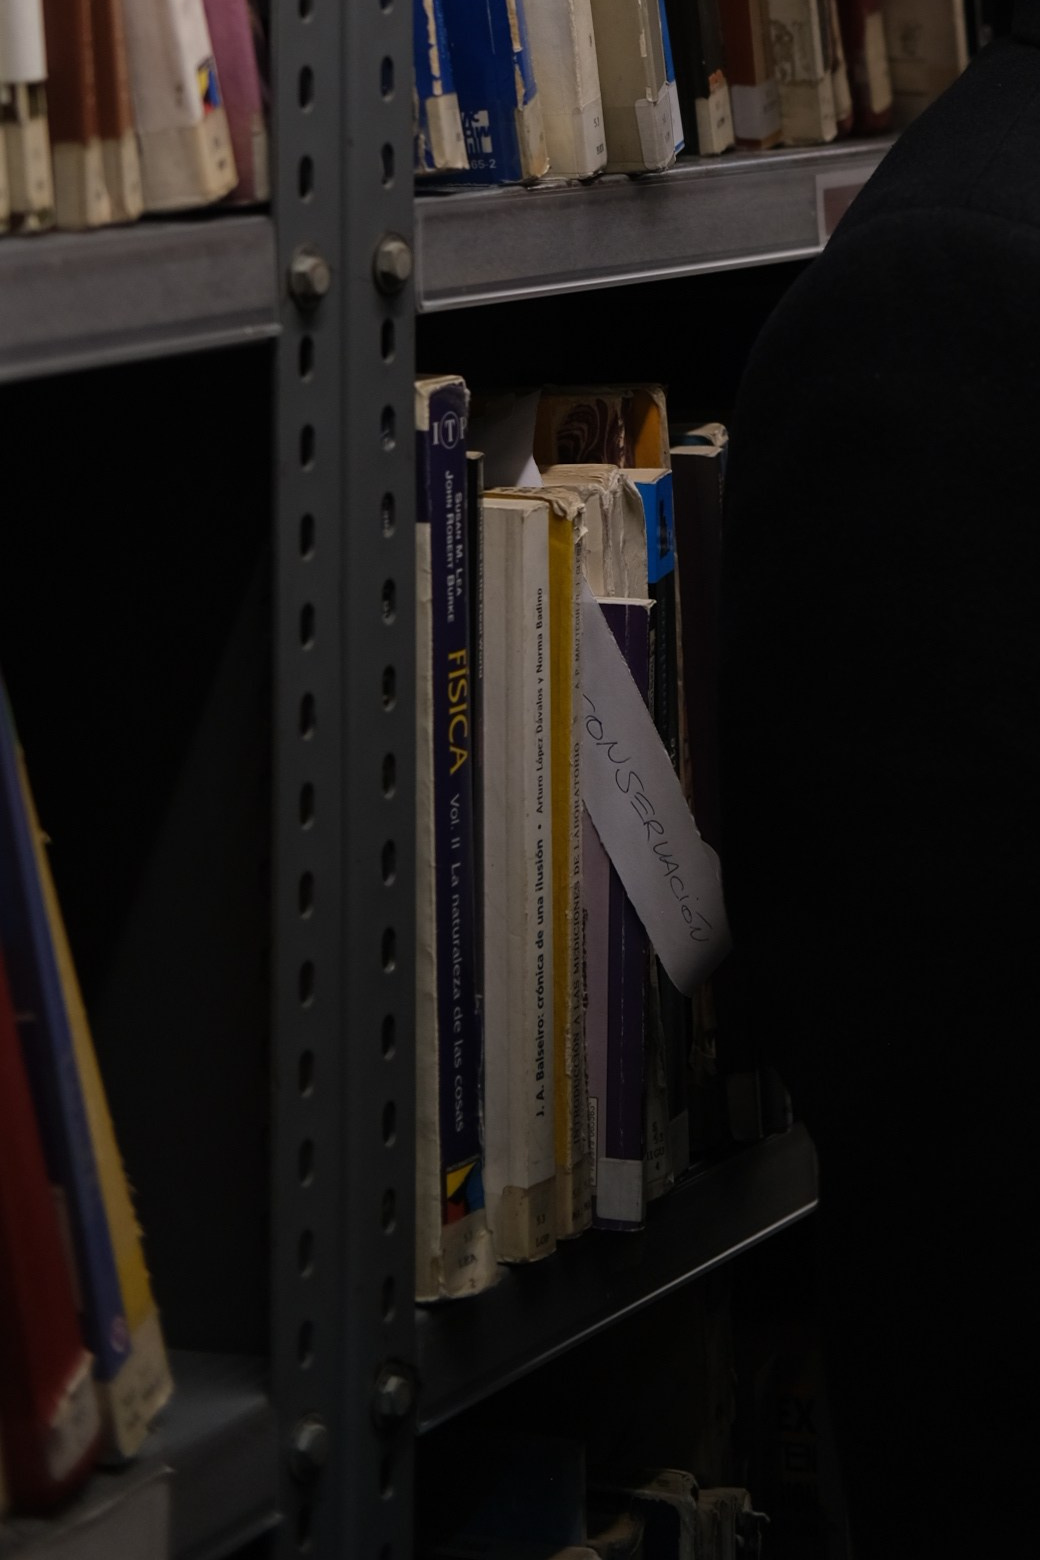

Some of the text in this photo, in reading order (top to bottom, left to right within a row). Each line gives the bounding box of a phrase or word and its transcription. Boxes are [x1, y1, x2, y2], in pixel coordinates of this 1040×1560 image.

[454, 491, 463, 540] SUSAN
[445, 470, 456, 624] JOHN ROBERT BURKE
[455, 568, 464, 597] LEA
[535, 587, 543, 628] Badino
[535, 632, 543, 672] Norma
[534, 688, 543, 733] Dávalos
[534, 737, 545, 771] López
[449, 793, 461, 830] Vol.
[535, 775, 544, 813] Arturo
[572, 742, 581, 849] LABORATORIO
[450, 862, 462, 887] La
[534, 837, 545, 891] ilusión
[573, 856, 582, 875] DE
[536, 897, 545, 924] una
[573, 881, 582, 975] MEDICIONES
[451, 894, 463, 1000] naturaleza
[535, 930, 545, 948] de
[535, 951, 545, 1009] crónica
[573, 980, 582, 1010] LAS
[452, 1006, 464, 1033] de
[453, 1039, 465, 1069] las
[535, 1012, 545, 1081] Balseiro:
[453, 1074, 466, 1133] cosas
[536, 1085, 545, 1100] A.
